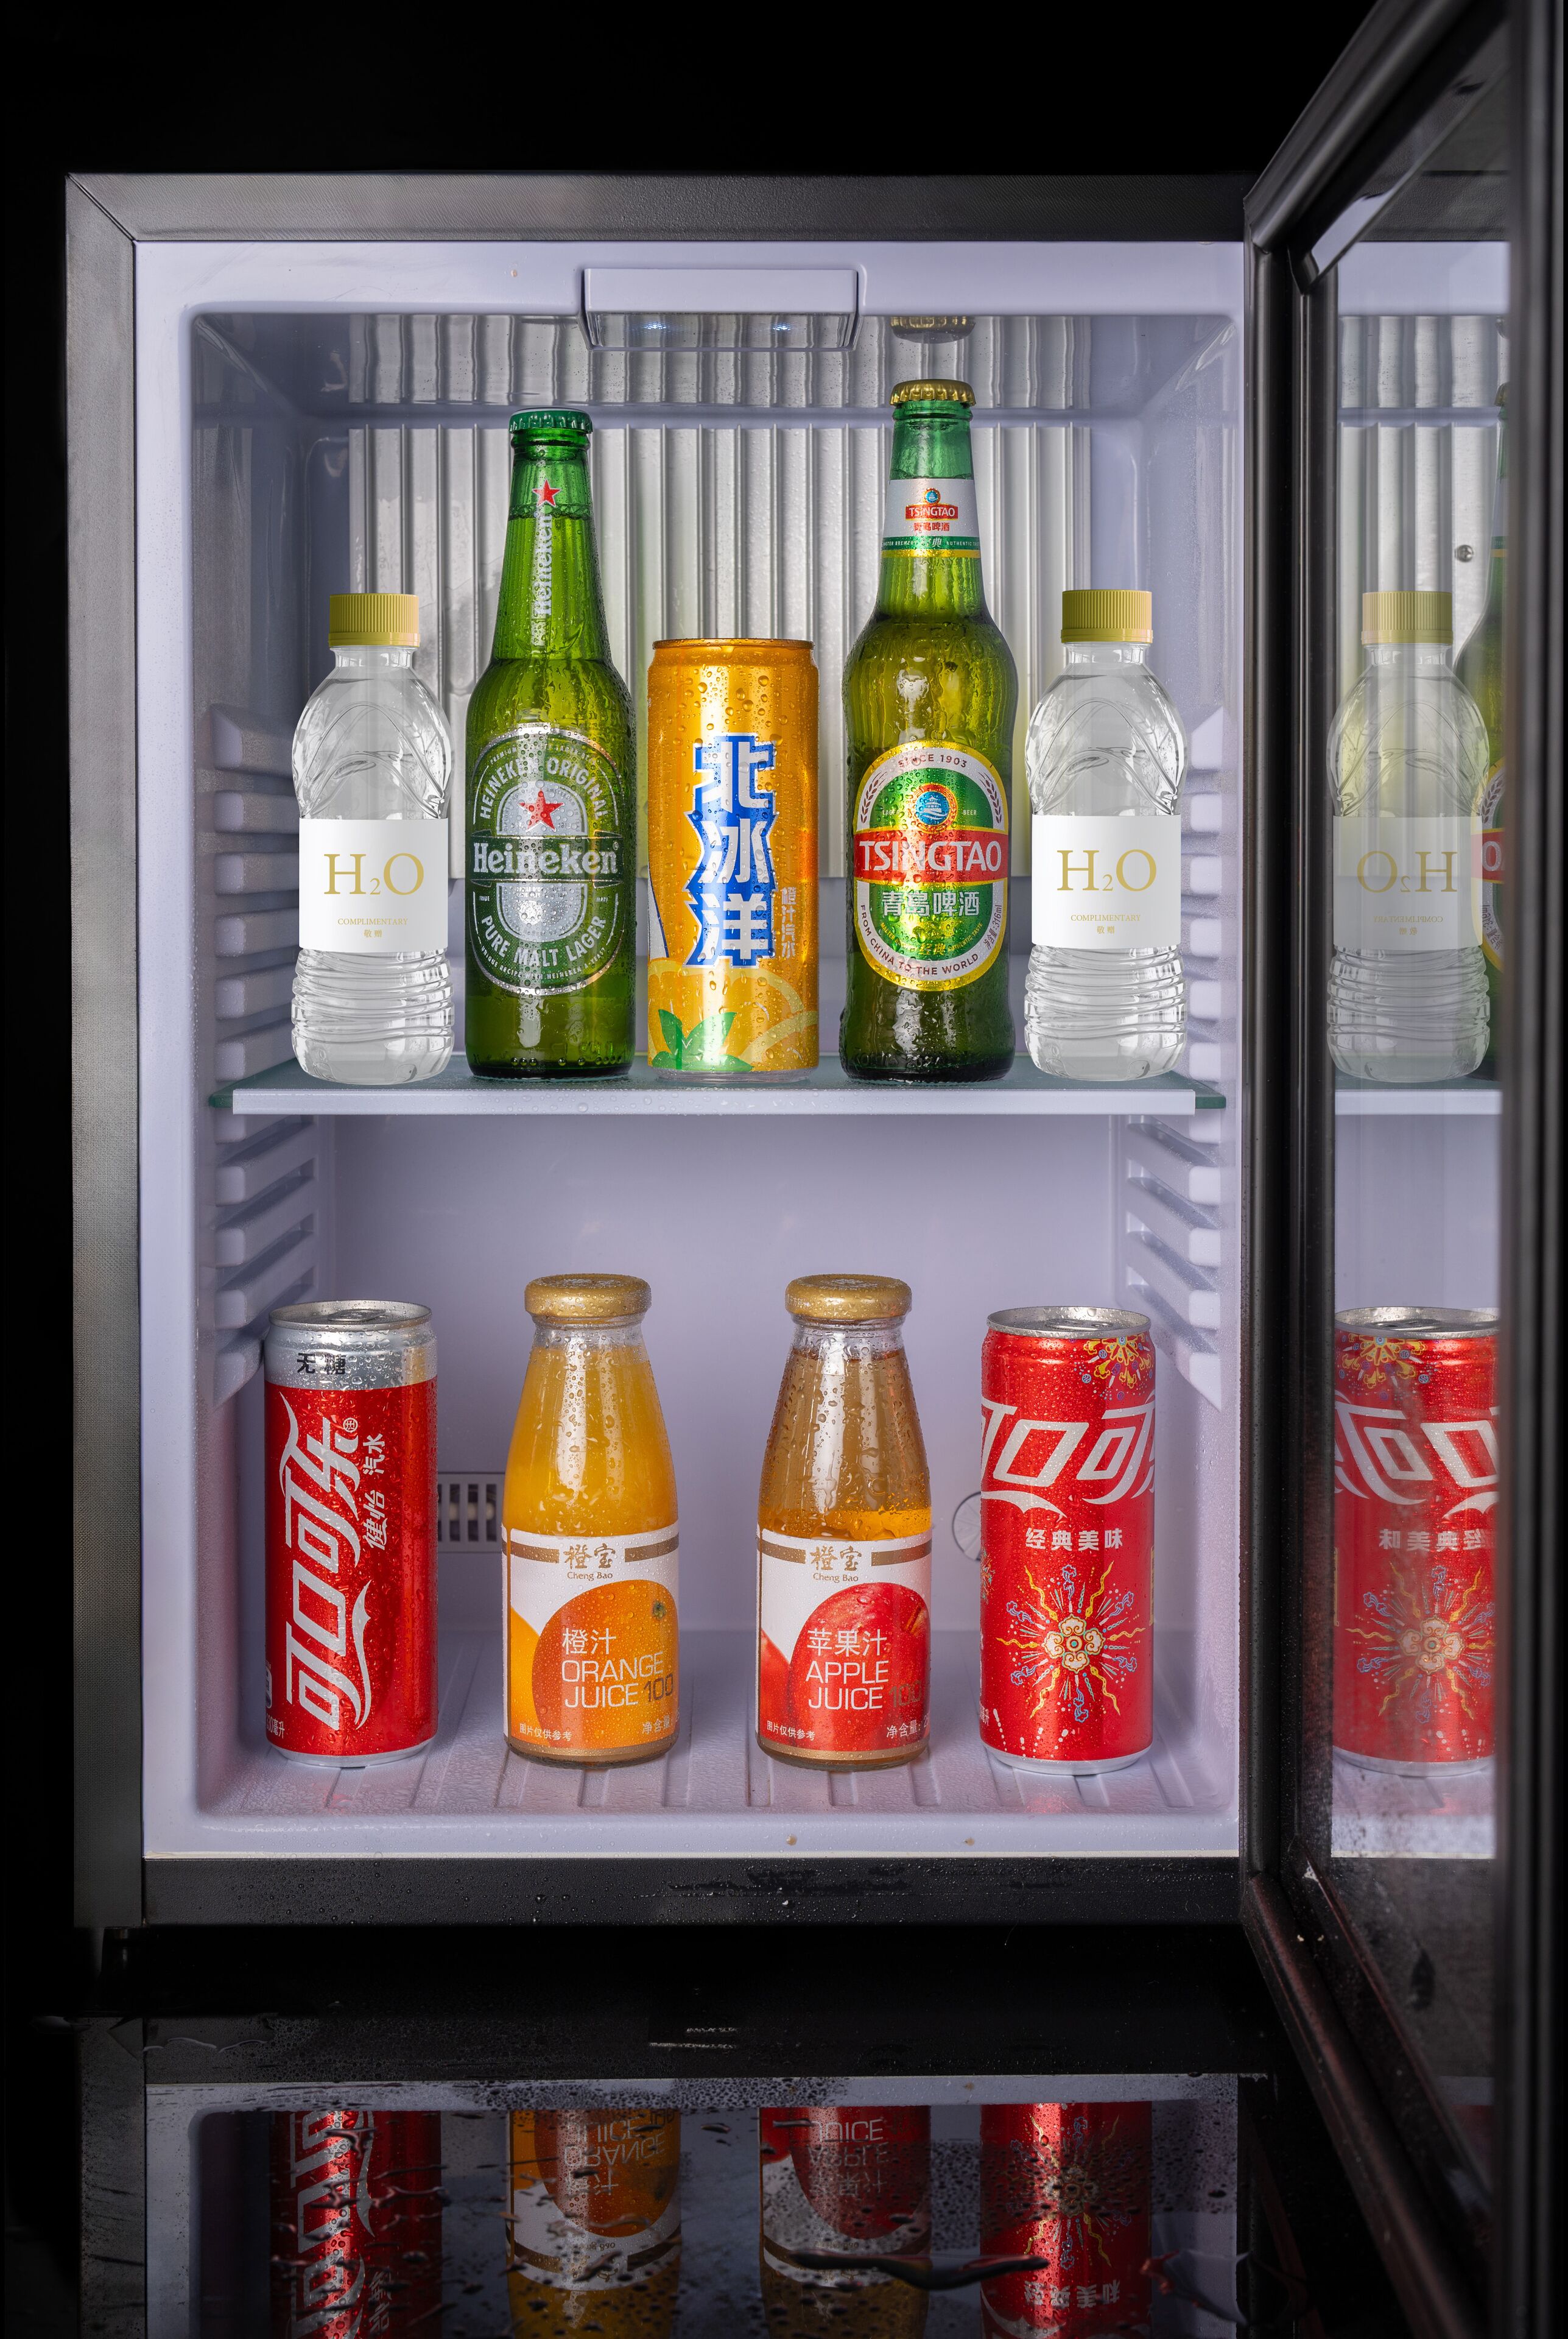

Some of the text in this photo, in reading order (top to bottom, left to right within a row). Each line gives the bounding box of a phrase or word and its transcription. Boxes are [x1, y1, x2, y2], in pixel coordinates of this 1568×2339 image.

[909, 506, 955, 517] TSINGTAO
[533, 514, 552, 616] Heineken
[940, 755, 967, 768] 1903
[547, 757, 609, 820] ORIGINAL
[474, 842, 618, 874] Heineken
[698, 741, 773, 960] 北冰洋
[859, 841, 1002, 872] TSINGTAO
[324, 853, 424, 895] H2O
[1057, 849, 1157, 892] H2O
[782, 887, 796, 959] 橙汁汽水
[947, 922, 983, 952] AUTHENTIC TASTE
[482, 915, 510, 958] PURE
[513, 947, 558, 967] MALT
[565, 916, 606, 961] LAGER
[860, 905, 872, 937] FROM
[870, 938, 895, 965] CHINA
[898, 961, 912, 973] TO
[916, 967, 938, 975] THE
[942, 953, 979, 974] WORLD
[481, 945, 498, 967] UNIQUE
[547, 966, 582, 979] HEINEKEN
[297, 1352, 346, 1375] 无糖
[363, 1433, 387, 1550] 健怡 汽水
[1026, 1528, 1123, 1552] 经典美味
[279, 1391, 371, 1730] 可口可乐
[567, 1571, 594, 1581] Cheng
[813, 1573, 840, 1583] Cheng
[562, 1628, 617, 1656] 橙汁
[807, 1628, 888, 1657] 苹果汁
[562, 1651, 664, 1682] ORANGE
[806, 1660, 888, 1684] APPLE
[565, 1682, 639, 1709] JUICE
[808, 1687, 883, 1710] JUICE
[519, 1723, 572, 1743] 图片仅供参考
[767, 1720, 816, 1741] 图片仅供参考
